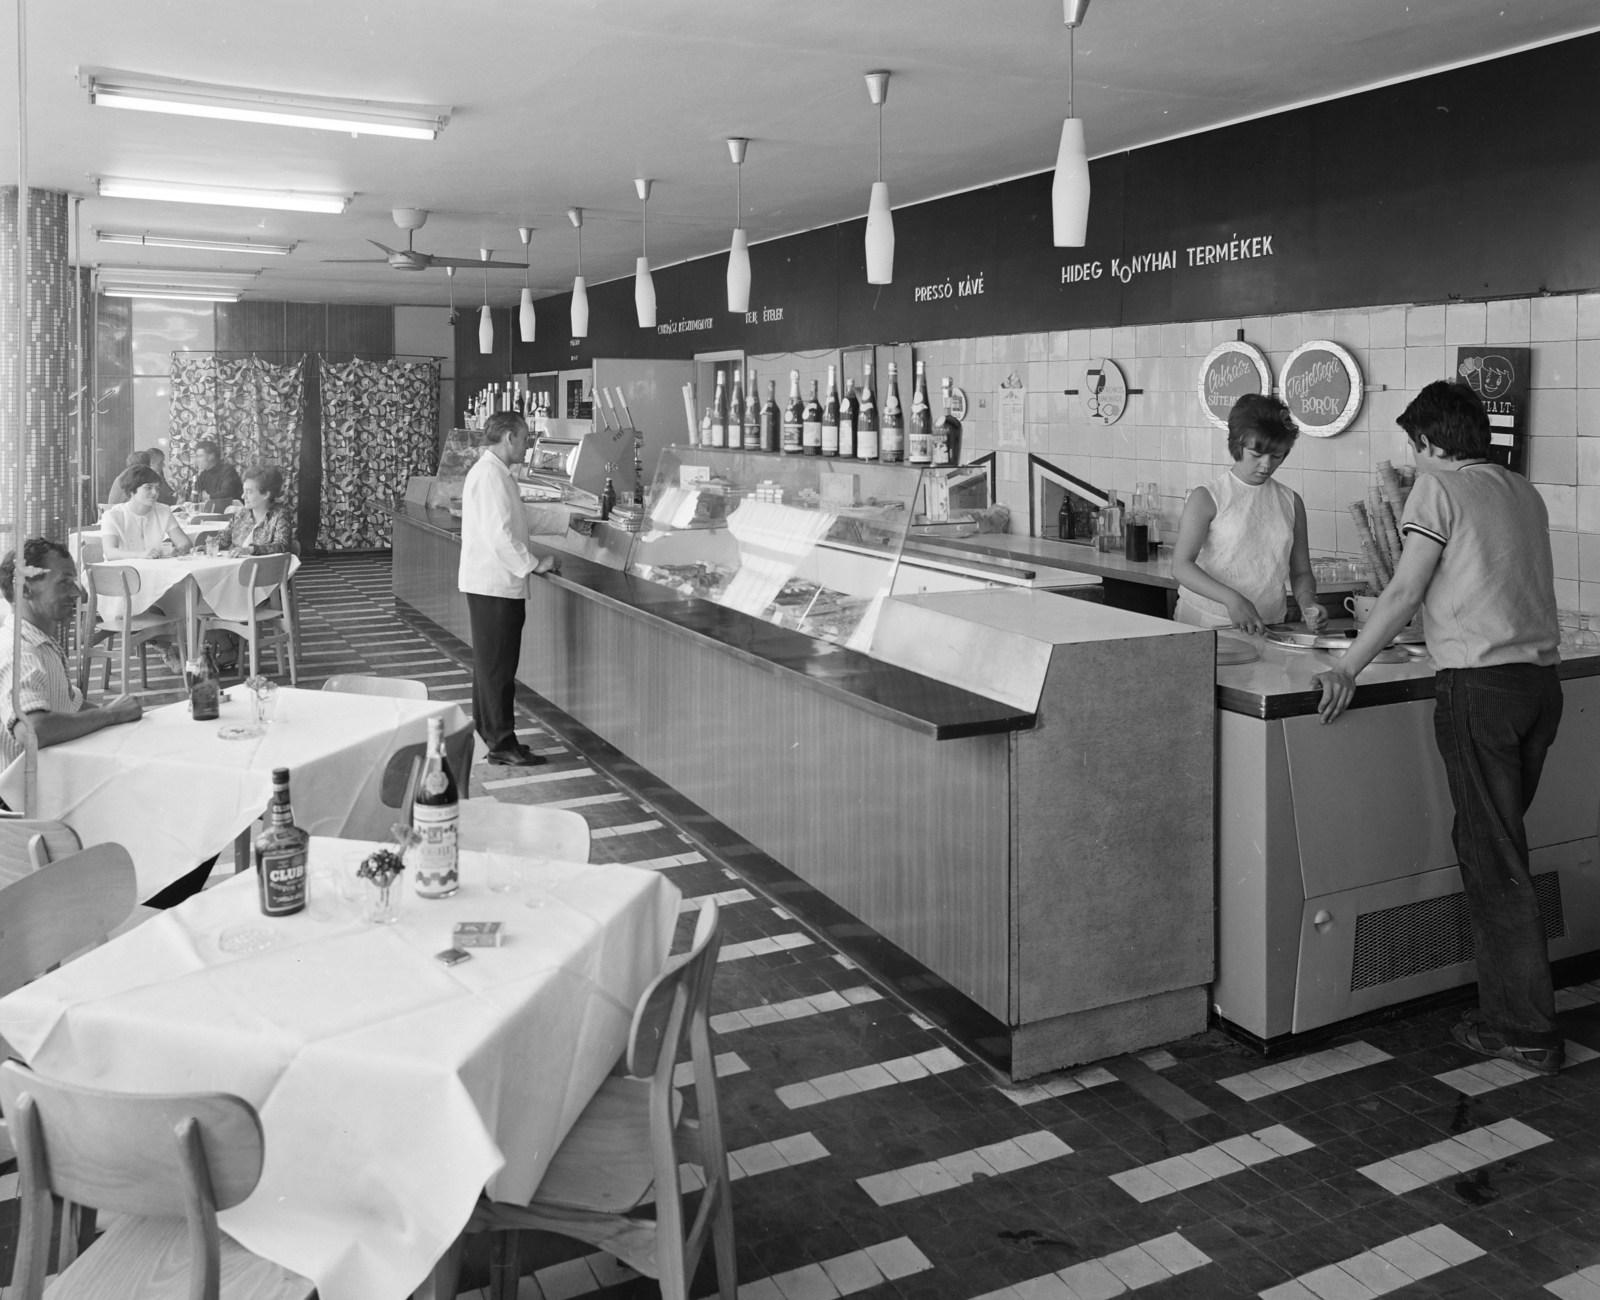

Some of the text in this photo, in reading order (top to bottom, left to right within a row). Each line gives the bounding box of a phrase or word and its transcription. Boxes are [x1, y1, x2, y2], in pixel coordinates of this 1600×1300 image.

[1061, 233, 1274, 284] HIDEG KONYHAI TERMÉKEK
[915, 271, 985, 302] PRESSÓ KÁVÉ
[763, 305, 784, 322] ÉTELEK
[1208, 357, 1251, 394] Cukrász
[1300, 396, 1340, 416] BOROK
[269, 864, 304, 883] CLUB
